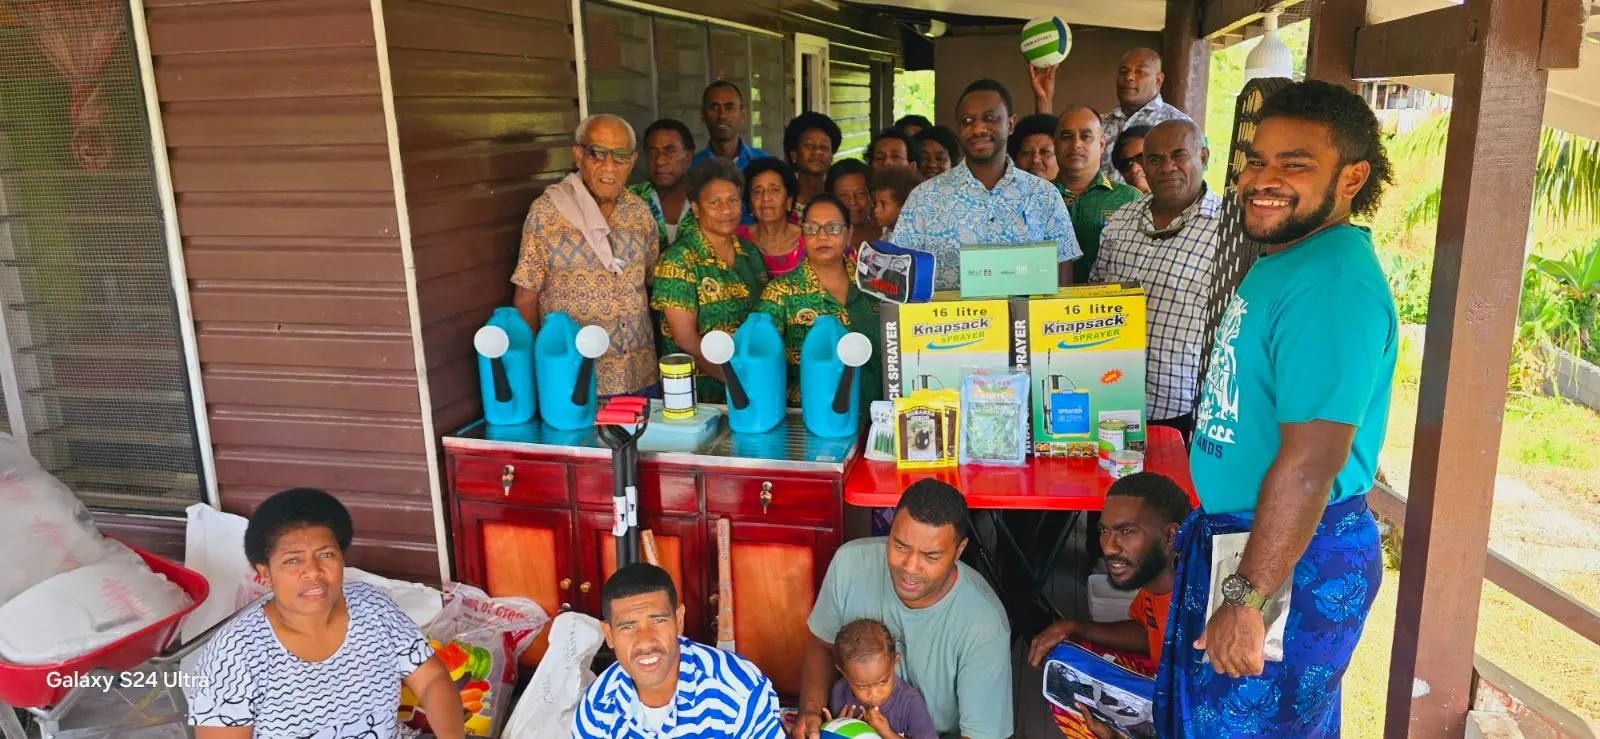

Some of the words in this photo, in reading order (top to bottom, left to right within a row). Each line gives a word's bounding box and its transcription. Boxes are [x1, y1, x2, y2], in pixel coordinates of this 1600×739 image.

[932, 307, 948, 318] 16
[956, 306, 988, 317] litre
[1064, 305, 1081, 315] 16
[1089, 303, 1123, 314] litre
[912, 317, 991, 336] Knapsack
[1043, 313, 1126, 336] Knapsack
[940, 330, 985, 344] SPRAYER
[1072, 328, 1120, 343] SPRAYER
[885, 320, 900, 381] SPRAYER
[1014, 319, 1028, 372] PRAYER
[1195, 434, 1224, 459] ANDS
